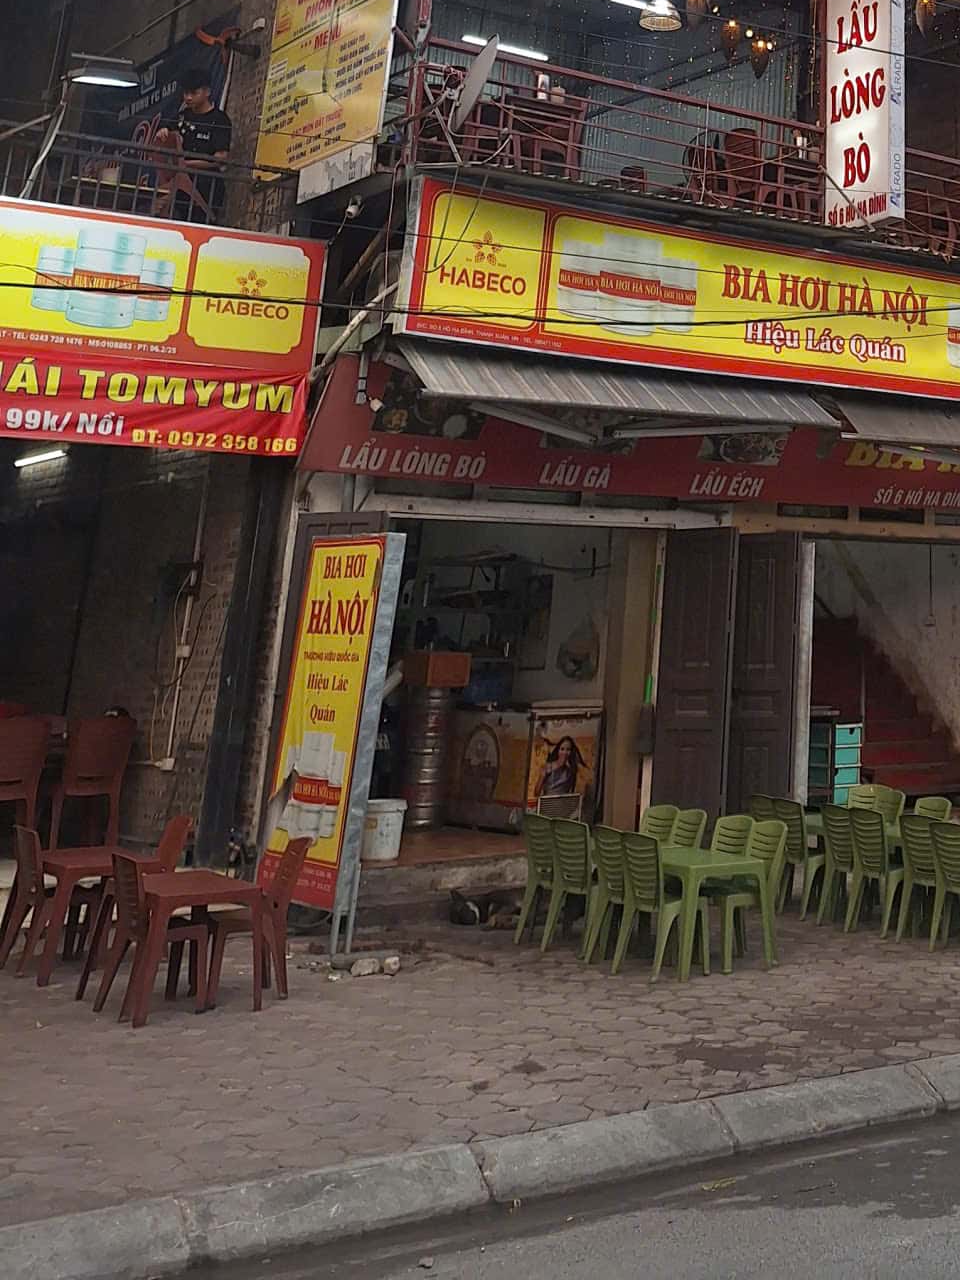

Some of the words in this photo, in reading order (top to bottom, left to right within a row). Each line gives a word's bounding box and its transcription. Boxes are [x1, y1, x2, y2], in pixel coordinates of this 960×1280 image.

[830, 68, 887, 124] LÒNG
[843, 132, 871, 188] BÒ
[828, 203, 838, 226] SỐ
[839, 207, 844, 225] 6
[868, 192, 887, 216] ĐÌNH
[439, 264, 528, 297] HABECO
[600, 278, 614, 290] BIA
[615, 280, 630, 292] HƠI
[631, 281, 643, 293] HÀ
[644, 283, 659, 298] NỘI
[205, 296, 289, 321] HABECO
[722, 263, 771, 303] BIA
[778, 271, 831, 313] HƠI
[838, 277, 881, 318] HÀ
[882, 286, 929, 332] NỘI
[744, 320, 802, 354] Hiệu
[805, 326, 844, 355] Lác
[849, 333, 906, 363] Quán
[0, 357, 62, 397] ÁI
[78, 368, 295, 414] TOMYUM
[168, 430, 217, 448] 0972
[221, 433, 258, 451] 358
[264, 437, 298, 452] 166
[338, 438, 387, 472] LẨU
[389, 444, 449, 478] LÒNG
[453, 450, 486, 480] BÒ
[583, 459, 612, 490] GÀ
[689, 468, 727, 497] LẨU
[727, 472, 765, 499] ẾCH
[873, 485, 895, 504] SỐ
[894, 489, 904, 504] 6
[323, 556, 342, 579] BIA
[344, 553, 368, 578] HƠI
[306, 590, 332, 635] HÀ
[333, 590, 369, 644] NỘI
[307, 672, 329, 695] Hiệu
[331, 673, 349, 692] Lác
[310, 703, 336, 725] Quán
